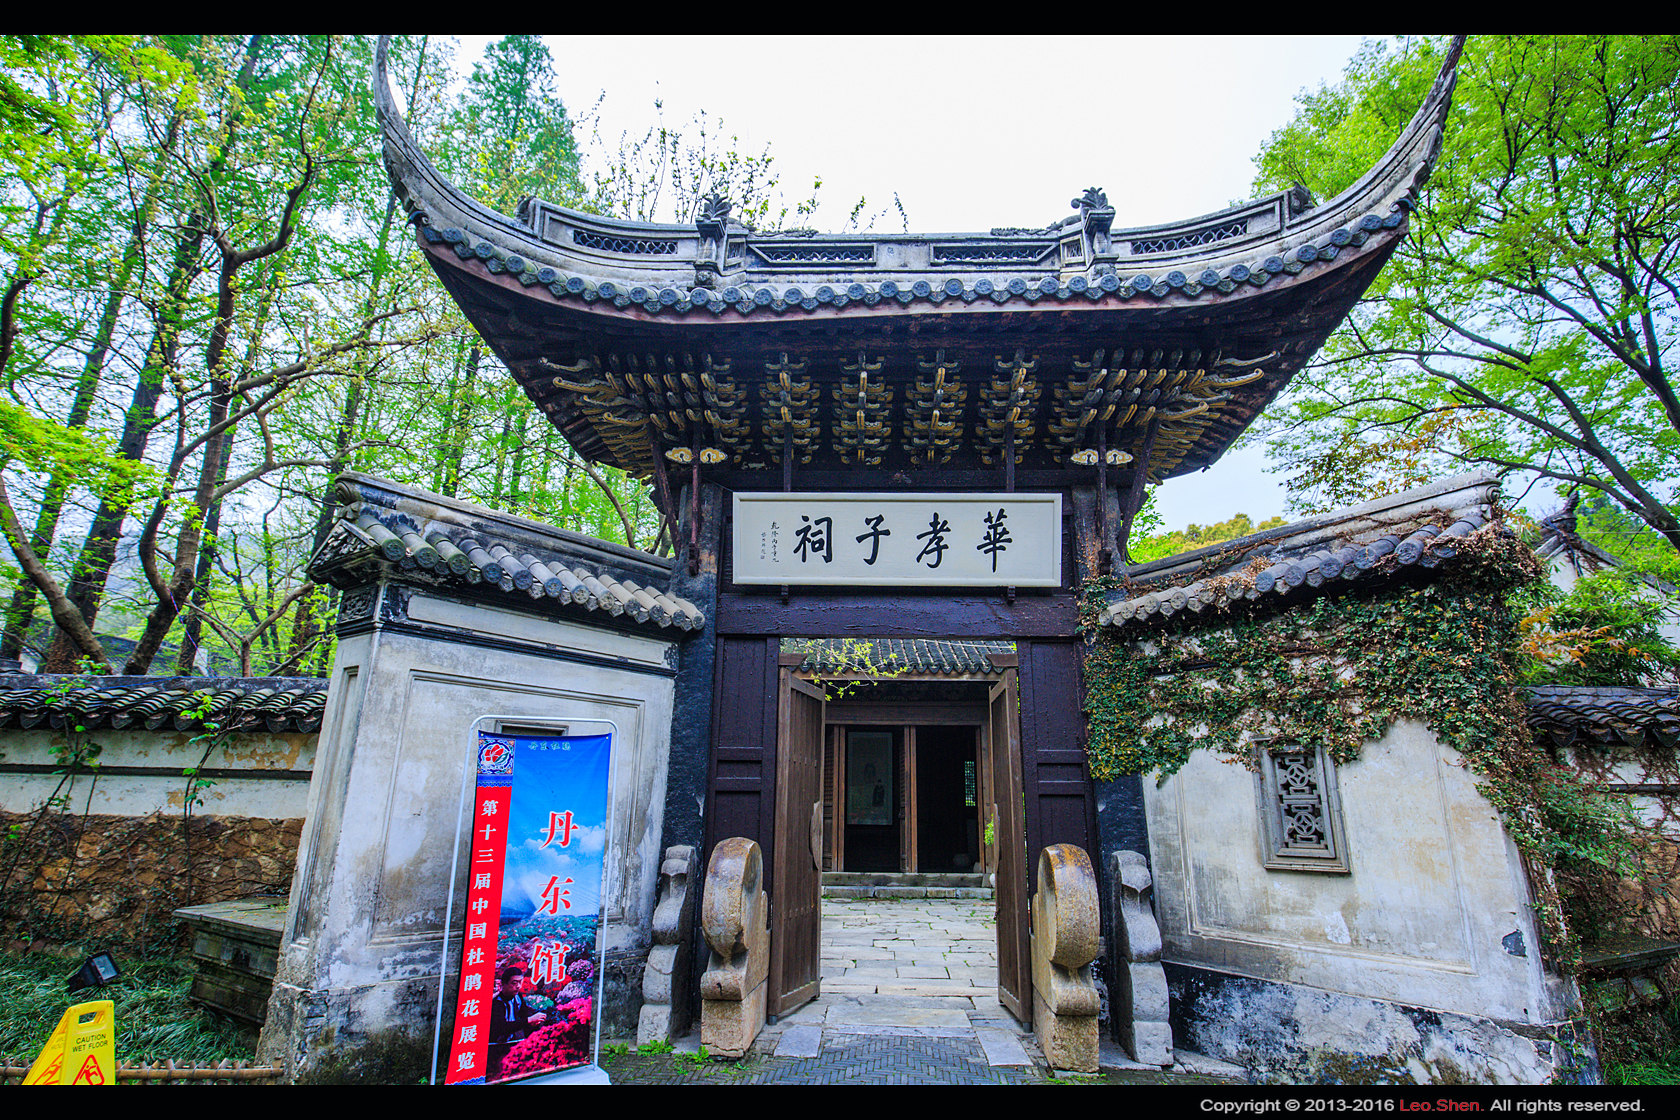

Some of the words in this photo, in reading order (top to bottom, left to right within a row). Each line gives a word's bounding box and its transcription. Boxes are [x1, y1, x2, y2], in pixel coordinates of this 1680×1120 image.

[456, 799, 499, 1073] 第十三届中国杜鹃花展览
[528, 810, 580, 985] 丹东馆
[72, 1044, 87, 1053] WET
[88, 1040, 108, 1049] FLOOR
[76, 1033, 106, 1045] CAUTION
